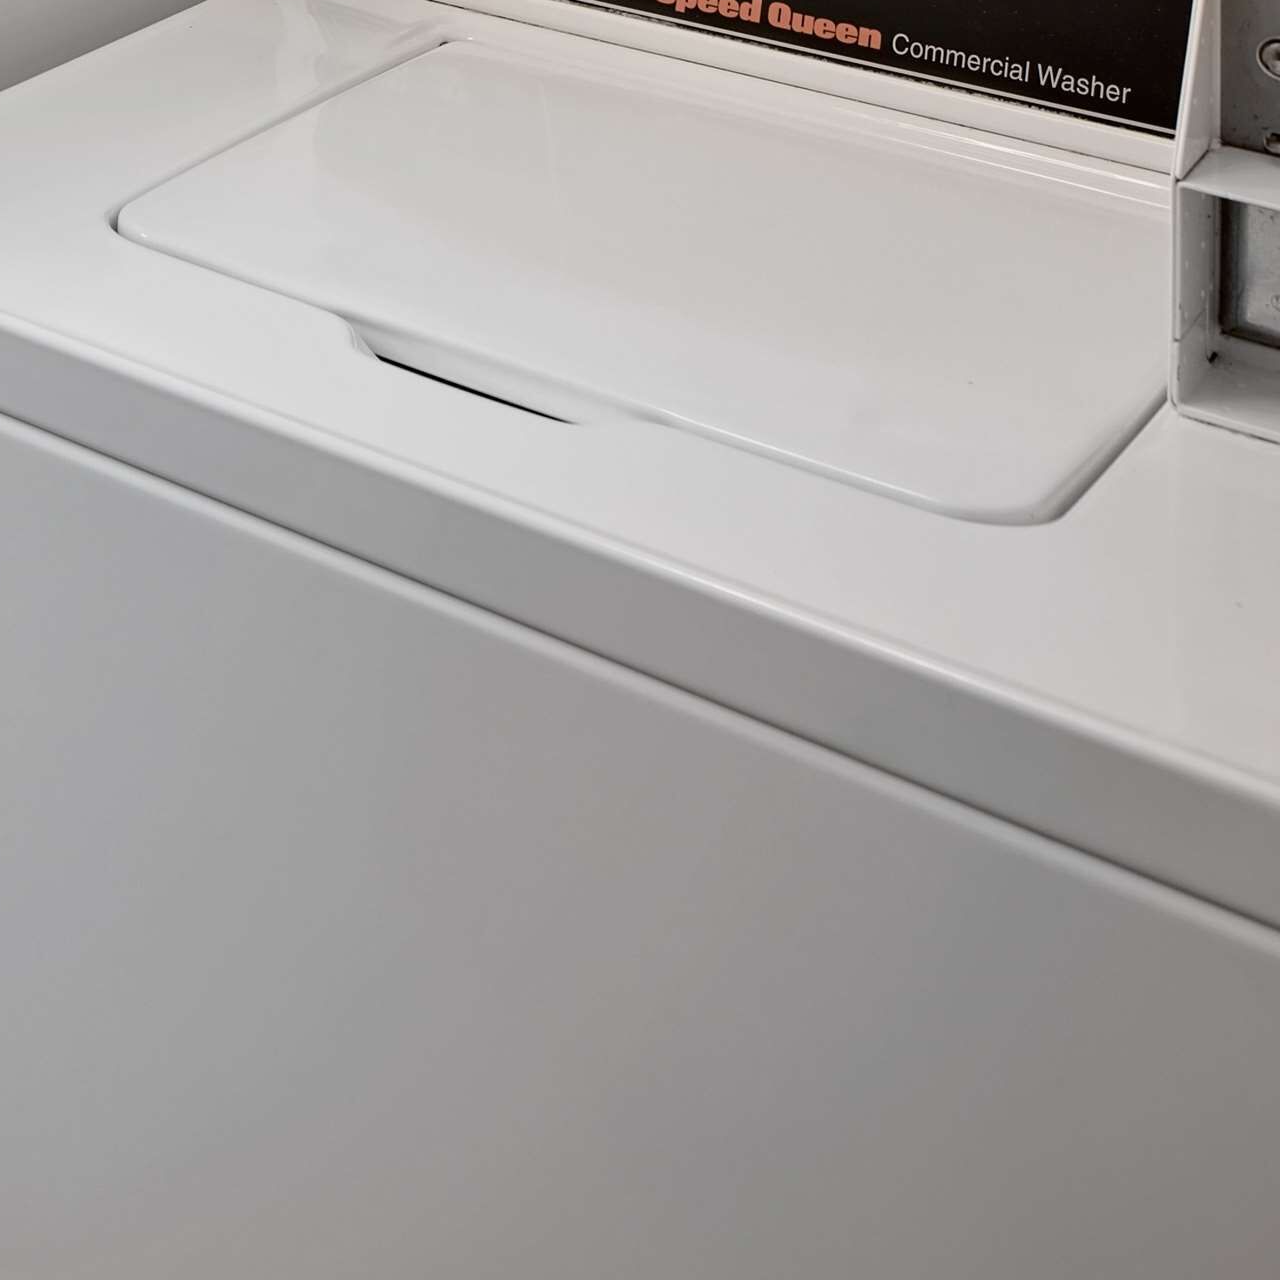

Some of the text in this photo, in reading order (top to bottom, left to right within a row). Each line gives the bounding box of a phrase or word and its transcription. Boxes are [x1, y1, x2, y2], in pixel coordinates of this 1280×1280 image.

[767, 1, 882, 50] Queen
[891, 32, 1030, 83] Commercial
[1038, 63, 1132, 105] Washer
